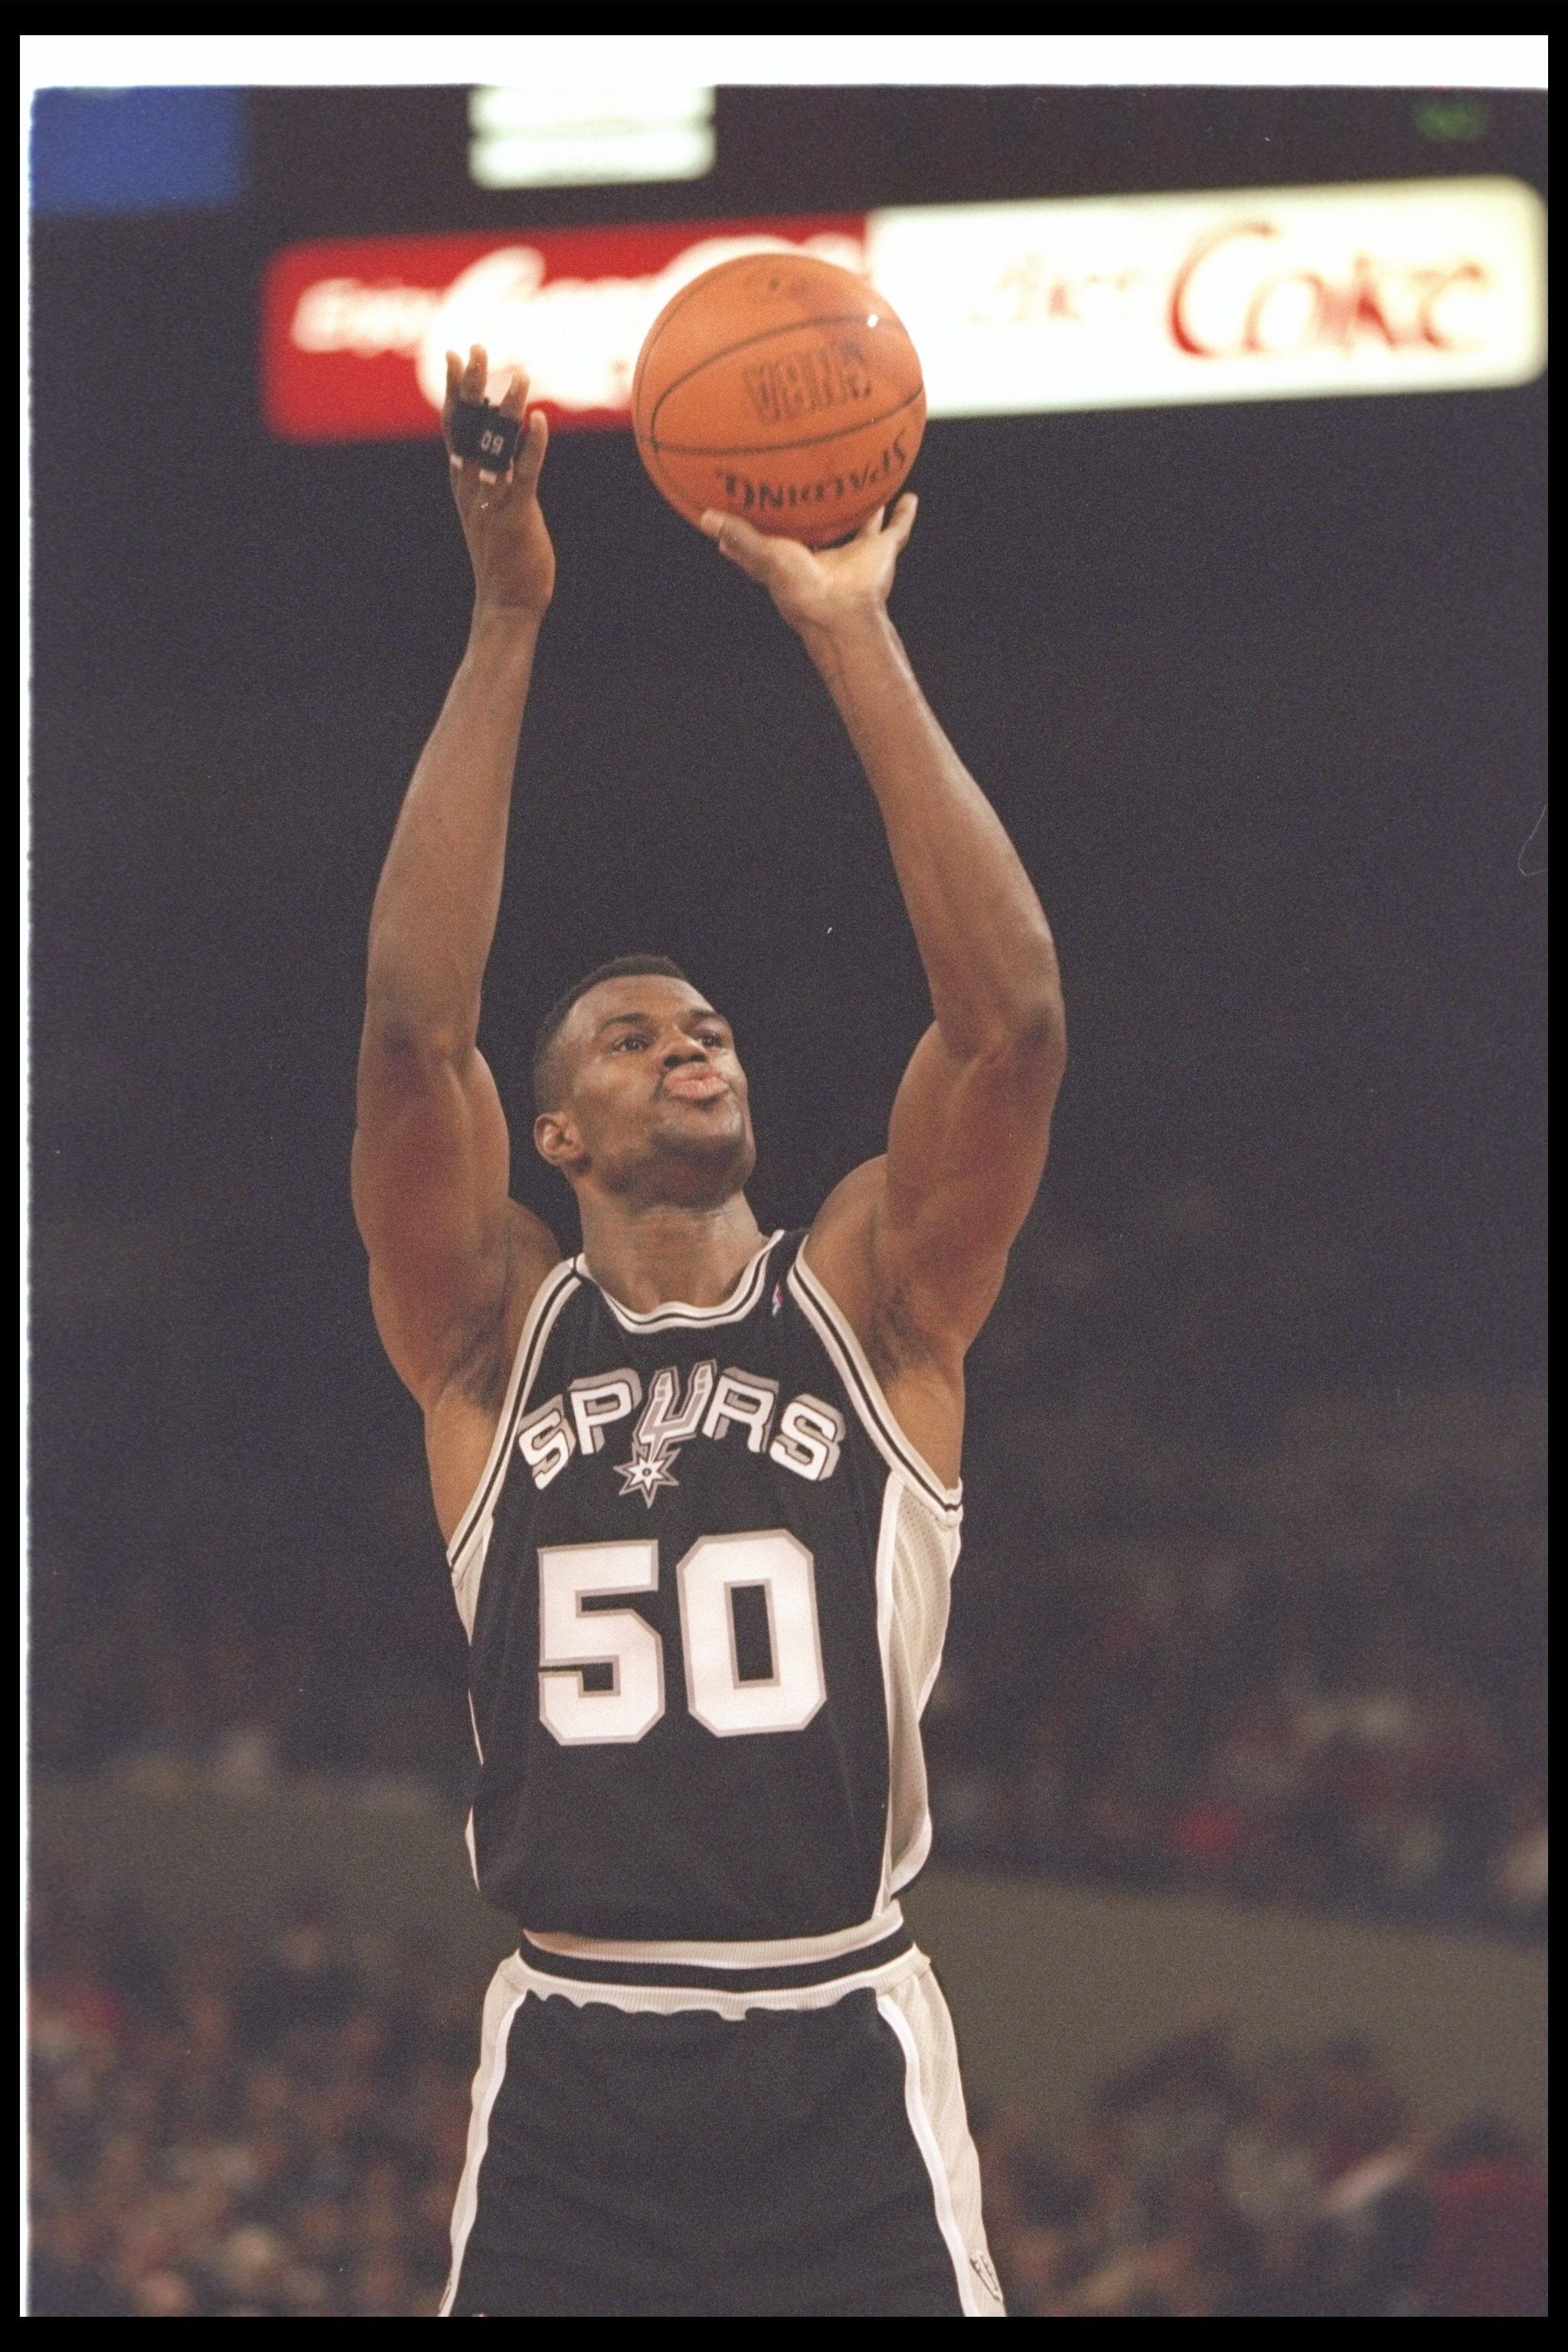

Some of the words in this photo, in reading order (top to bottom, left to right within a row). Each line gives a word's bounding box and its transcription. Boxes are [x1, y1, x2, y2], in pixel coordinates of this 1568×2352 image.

[724, 428, 907, 511] SPALDING
[517, 1359, 844, 1494] SPURS
[537, 1528, 827, 1746] 50
